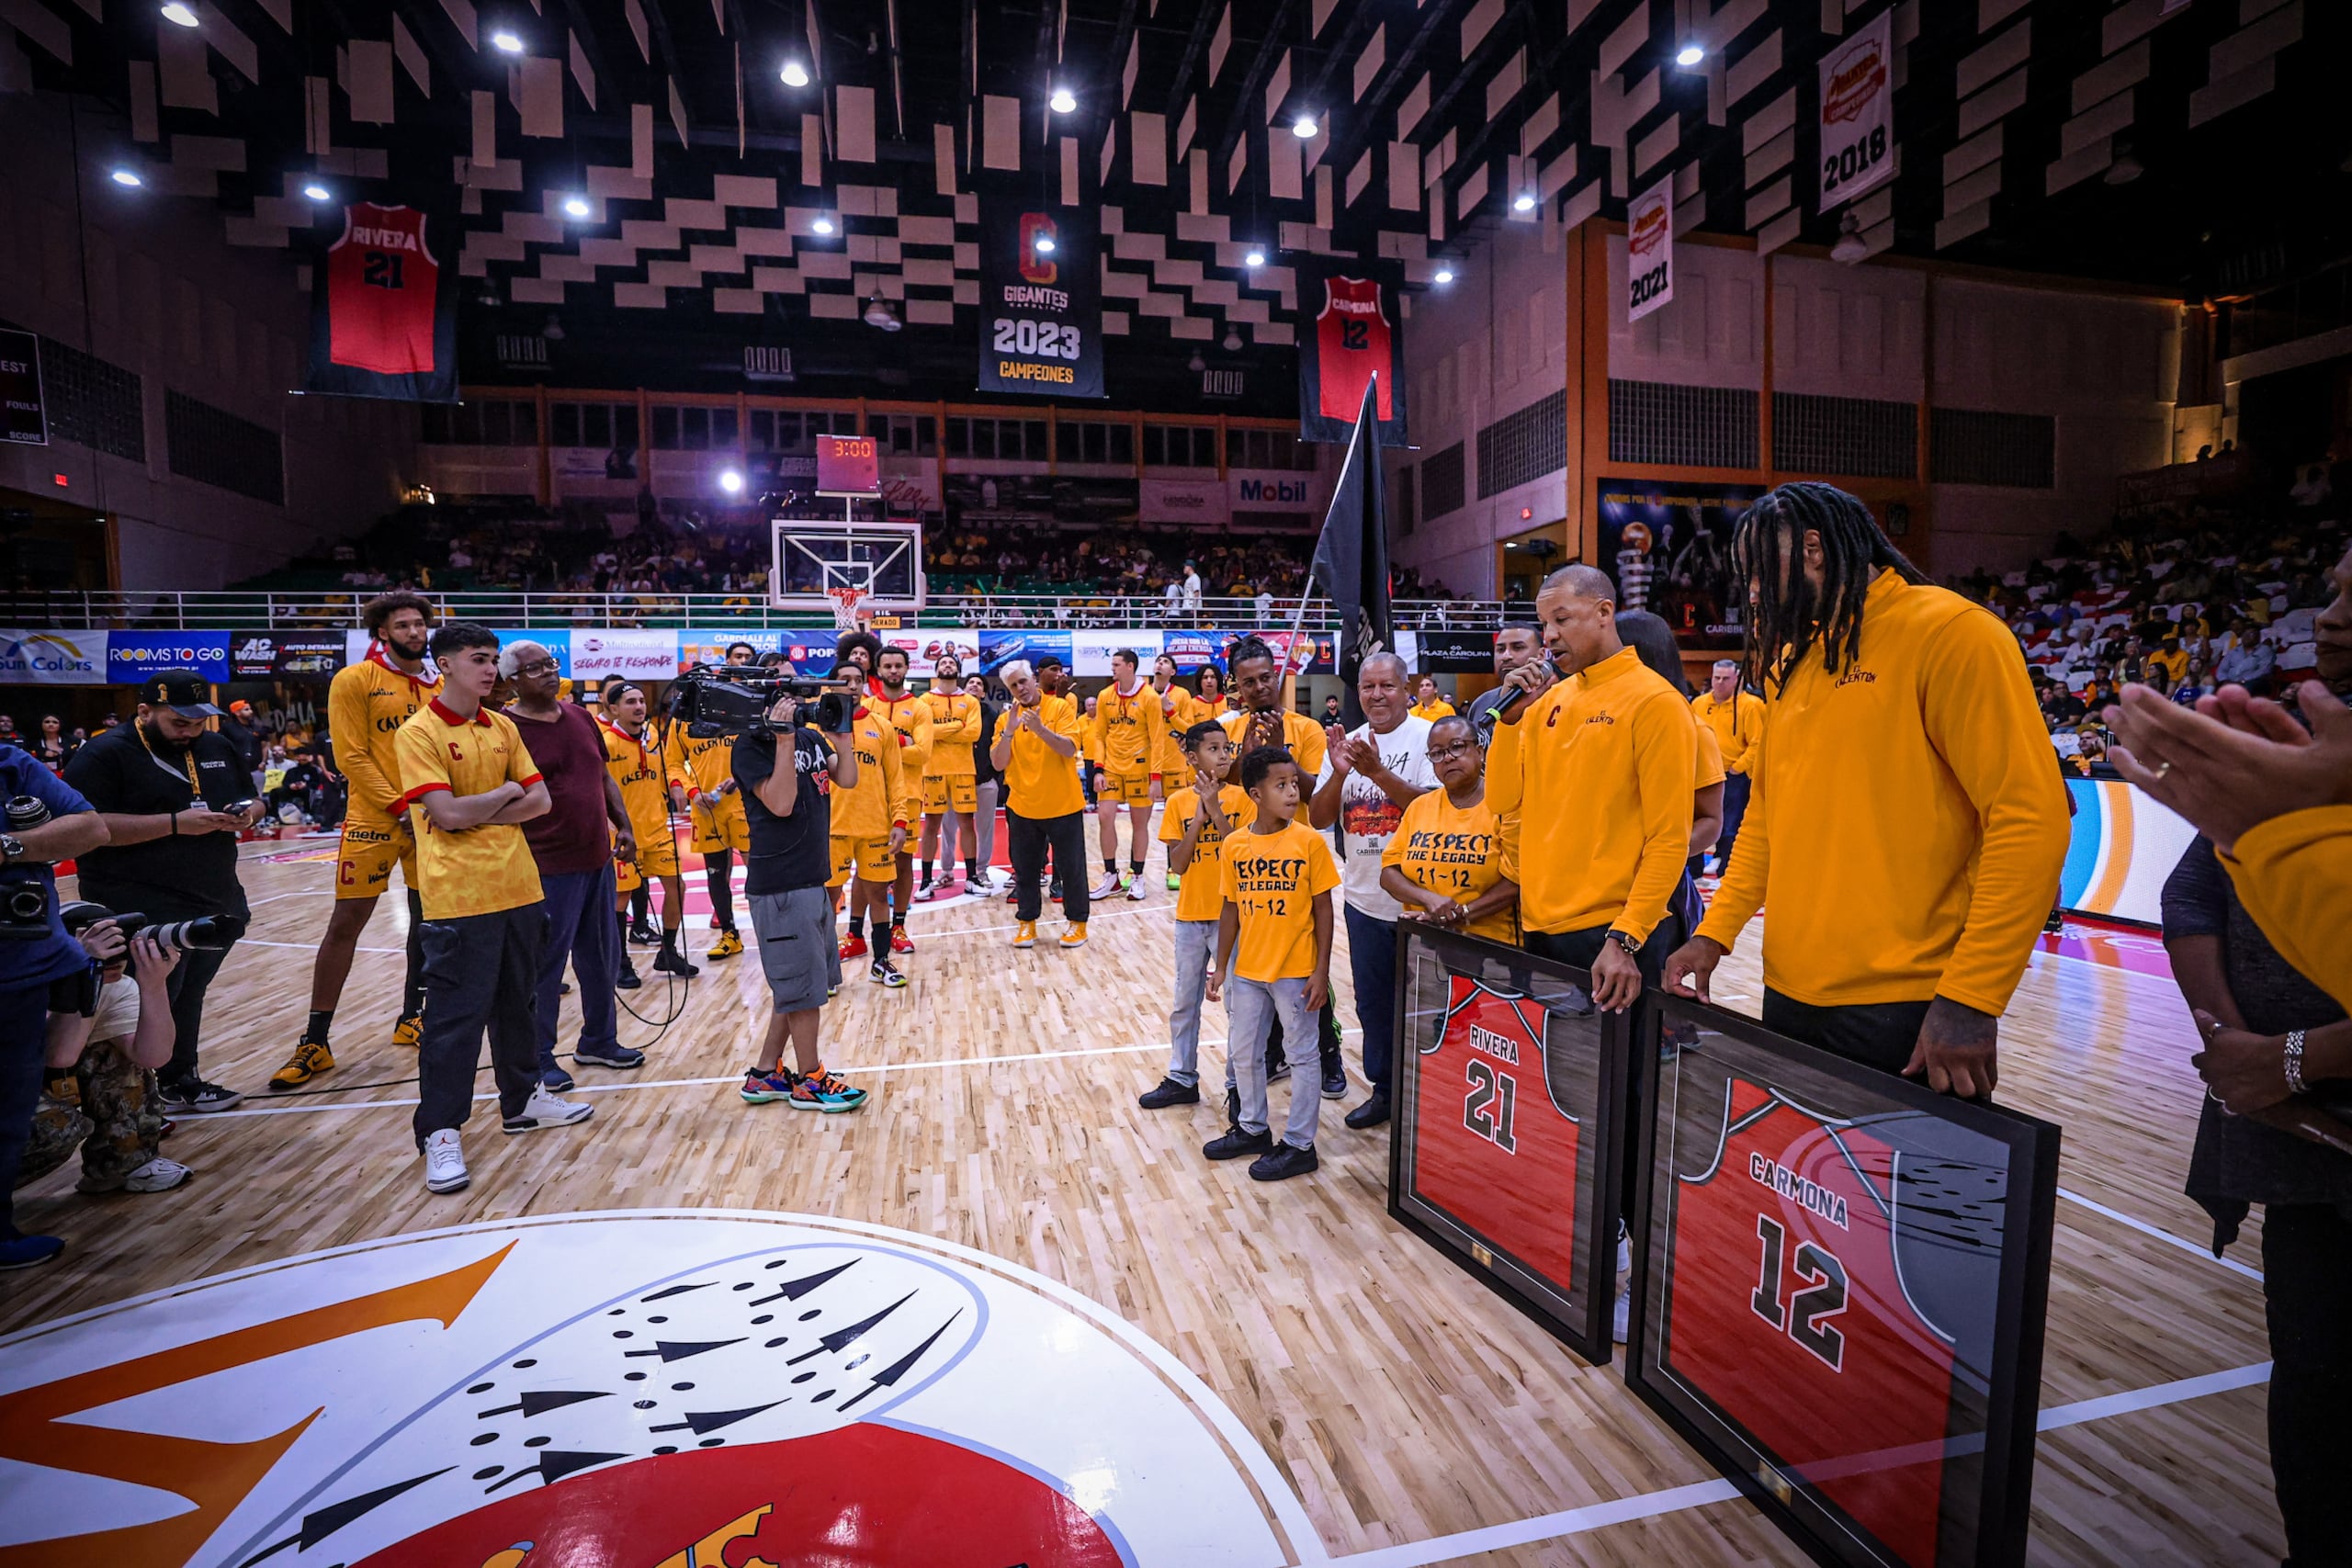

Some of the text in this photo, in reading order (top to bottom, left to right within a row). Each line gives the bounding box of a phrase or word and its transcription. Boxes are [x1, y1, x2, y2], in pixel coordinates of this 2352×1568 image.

[1824, 124, 1886, 192] 2018
[352, 226, 417, 252] RIVERA
[1019, 212, 1057, 284] C
[364, 251, 404, 288] 21
[1631, 261, 1668, 309] 2021
[1004, 286, 1069, 309] GIGANTES
[1332, 298, 1376, 314] CARMONA
[993, 318, 1081, 360] 2023
[1342, 318, 1369, 351] 12
[1000, 360, 1074, 384] CAMPEONES
[6, 400, 39, 412] FOULS
[9, 431, 42, 442] SCORE
[835, 440, 872, 457] 3:00
[1240, 479, 1306, 502] Mobil
[243, 638, 273, 651] AC
[306, 643, 345, 651] DETAILING
[765, 634, 777, 642] AL
[110, 647, 225, 661] ROOMS TO GO
[234, 650, 277, 660] WASH
[1320, 640, 1331, 660] C
[31, 656, 92, 671] Colors
[573, 655, 675, 670] SEGURO TE RESPONDE
[1546, 705, 1561, 728] C
[448, 742, 463, 761] C
[348, 830, 390, 841] metro
[1408, 830, 1492, 852] RESPECT
[1407, 851, 1487, 865] THE LEGACY
[341, 861, 356, 886] C
[616, 861, 628, 879] C
[1250, 880, 1296, 891] LEGACY
[1470, 1023, 1519, 1066] RIVERA
[1464, 1058, 1516, 1156] 21
[1749, 1151, 1849, 1232] CARMONA
[1751, 1212, 1849, 1373] 12
